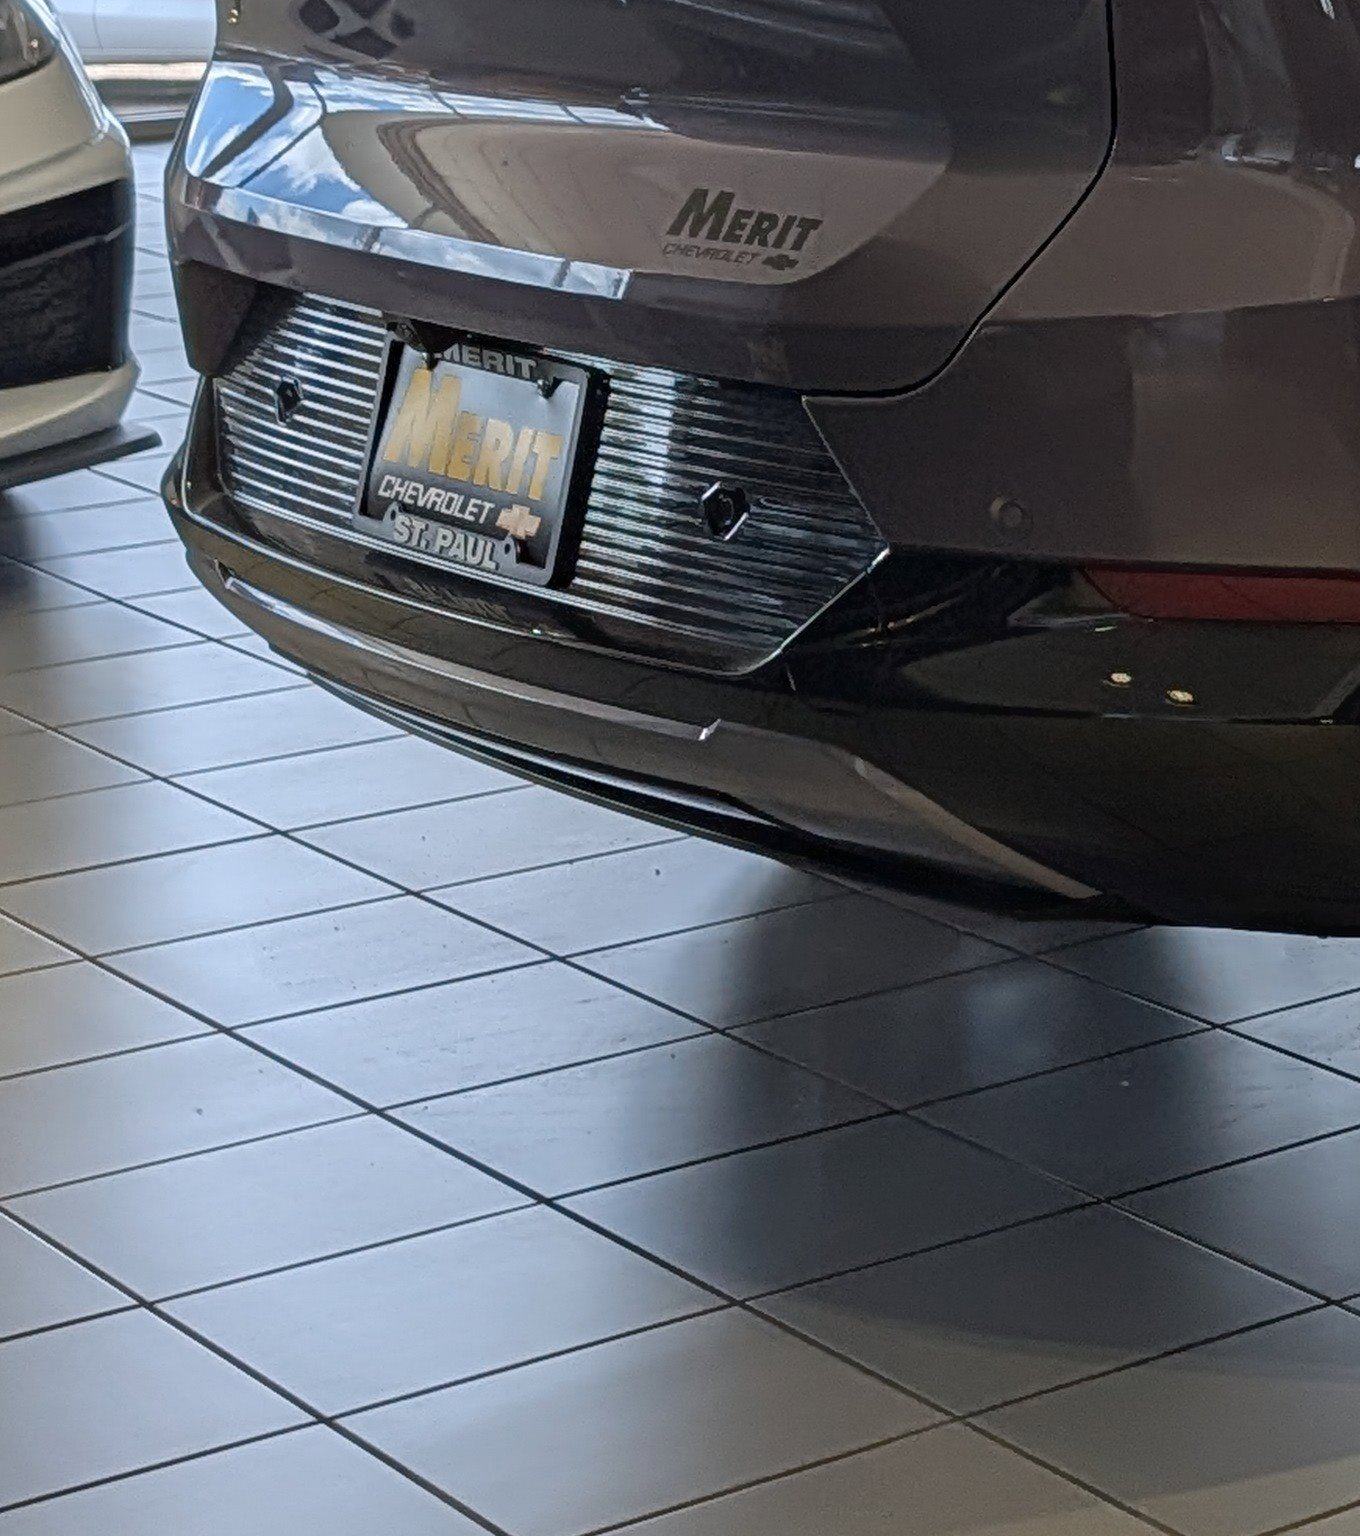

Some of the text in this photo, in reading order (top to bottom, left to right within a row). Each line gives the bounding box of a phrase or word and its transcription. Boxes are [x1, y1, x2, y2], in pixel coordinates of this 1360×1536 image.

[666, 188, 823, 251] MERIT
[662, 242, 761, 265] CHEVROLET
[384, 367, 563, 501] MERIT
[378, 475, 495, 522] CHEVROLET
[393, 514, 499, 571] ST. PAUL
